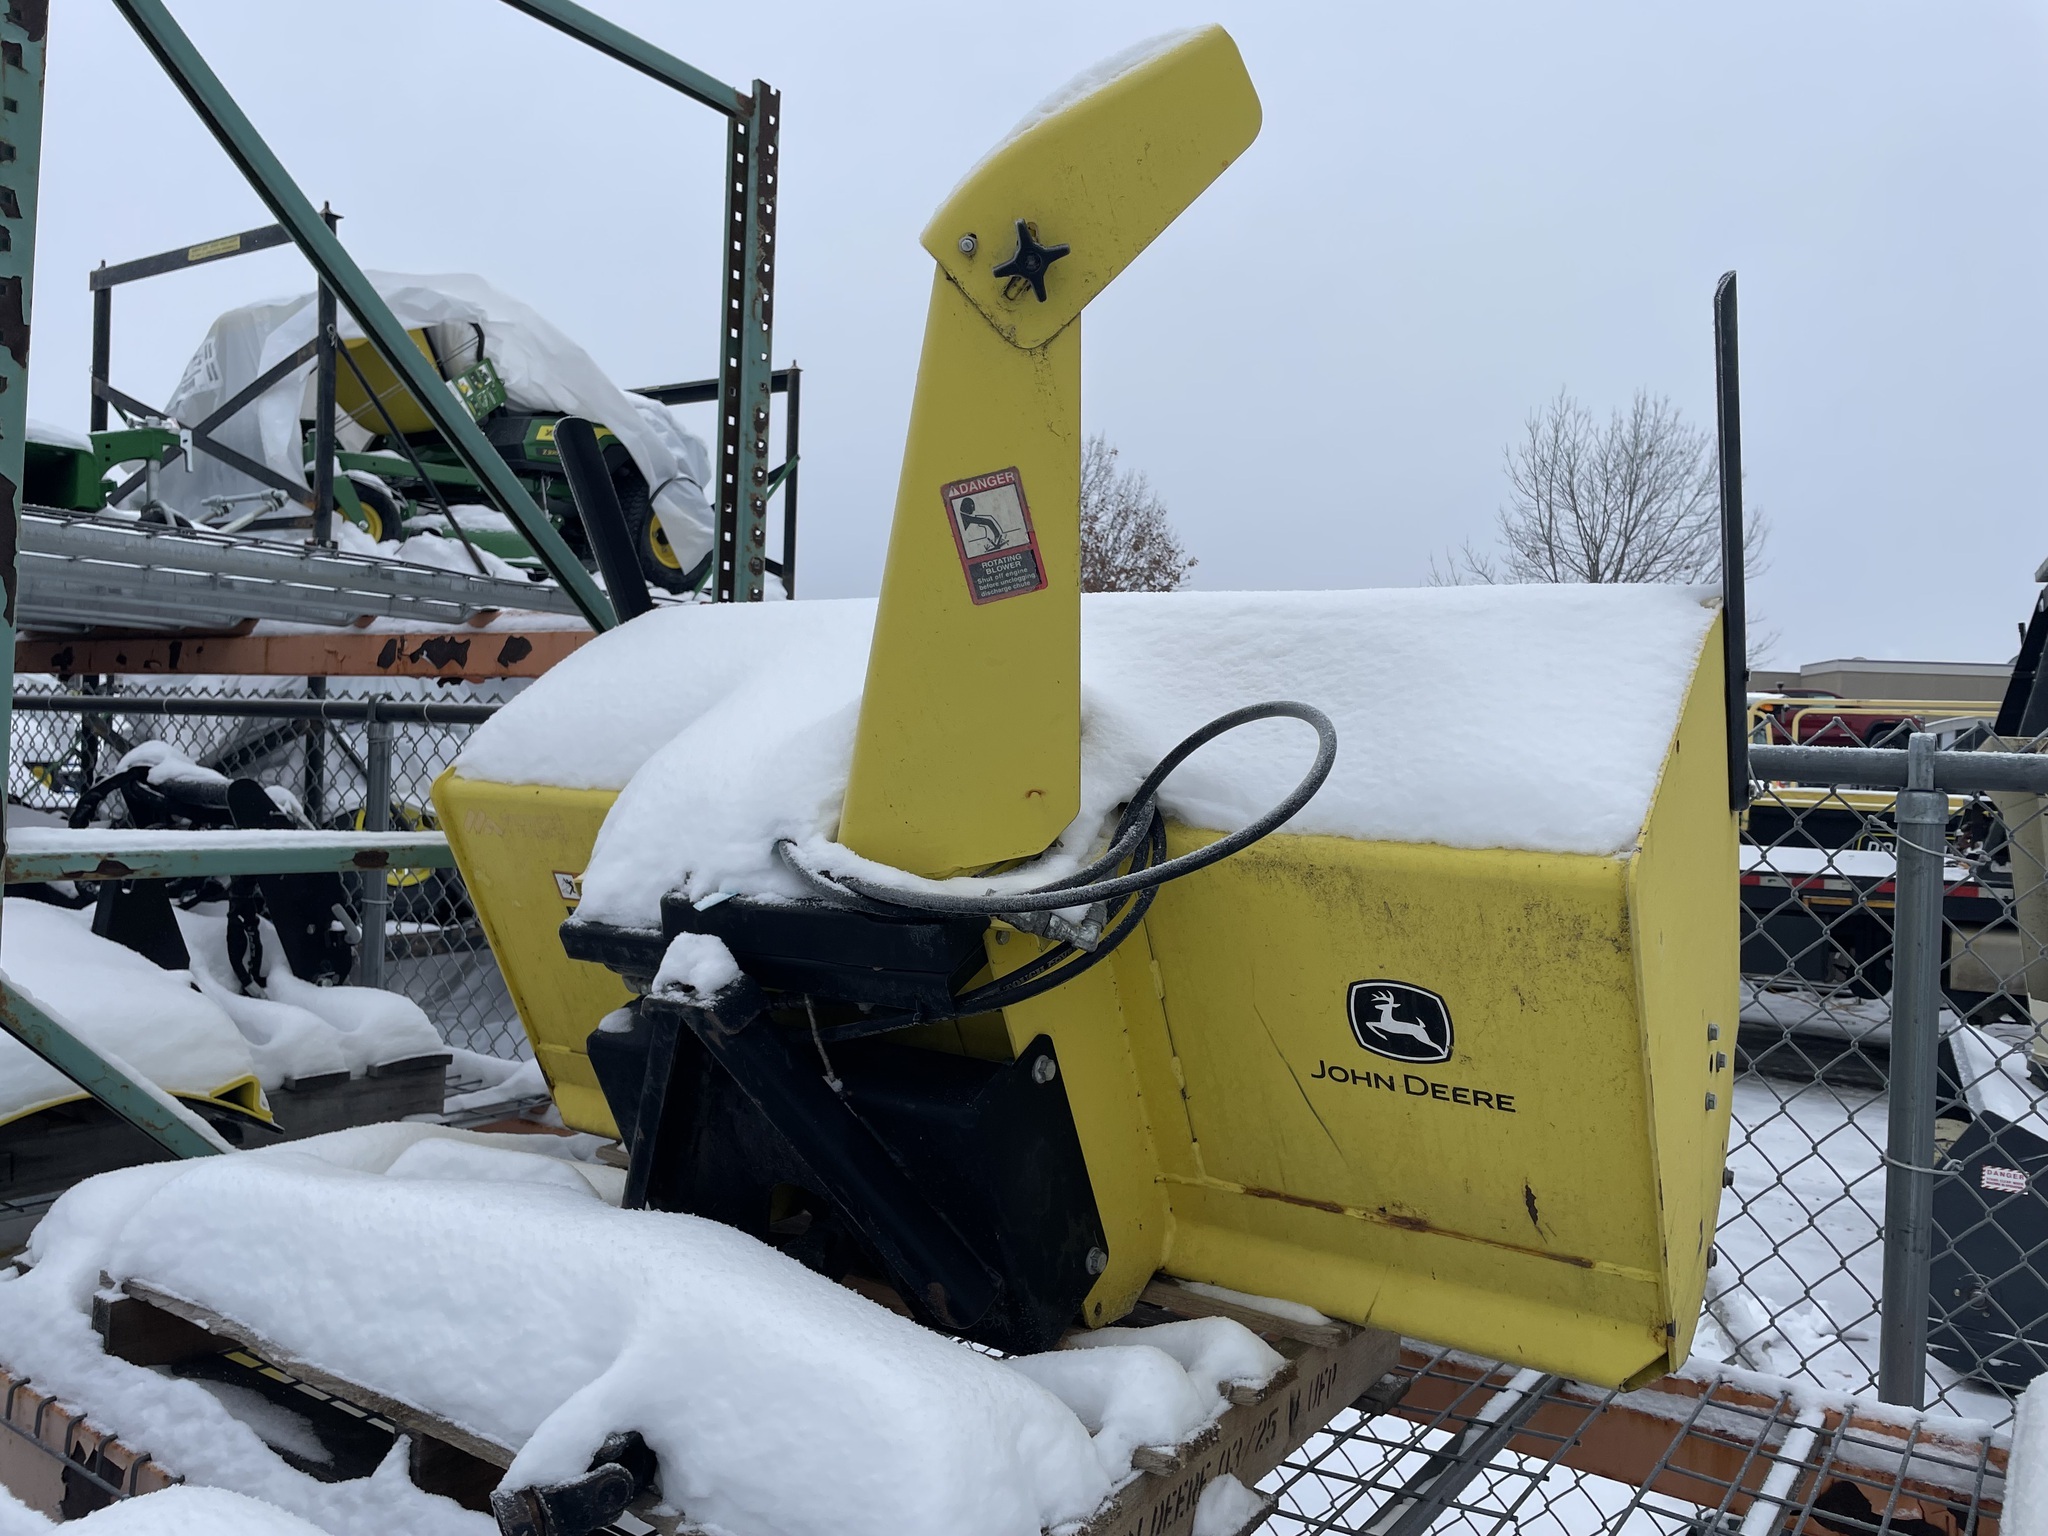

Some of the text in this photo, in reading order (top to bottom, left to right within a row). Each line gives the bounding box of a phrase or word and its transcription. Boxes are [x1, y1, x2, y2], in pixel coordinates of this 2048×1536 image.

[959, 471, 1015, 494] DANGER
[981, 553, 1022, 569] ROTATING
[986, 561, 1022, 575] BLOWER
[977, 567, 1028, 585] Shut off engine
[979, 572, 1036, 591] before unclogging
[981, 580, 1031, 597] discharge chute
[1311, 1059, 1516, 1113] JOHN DEERE
[1986, 1169, 2025, 1180] DANGER
